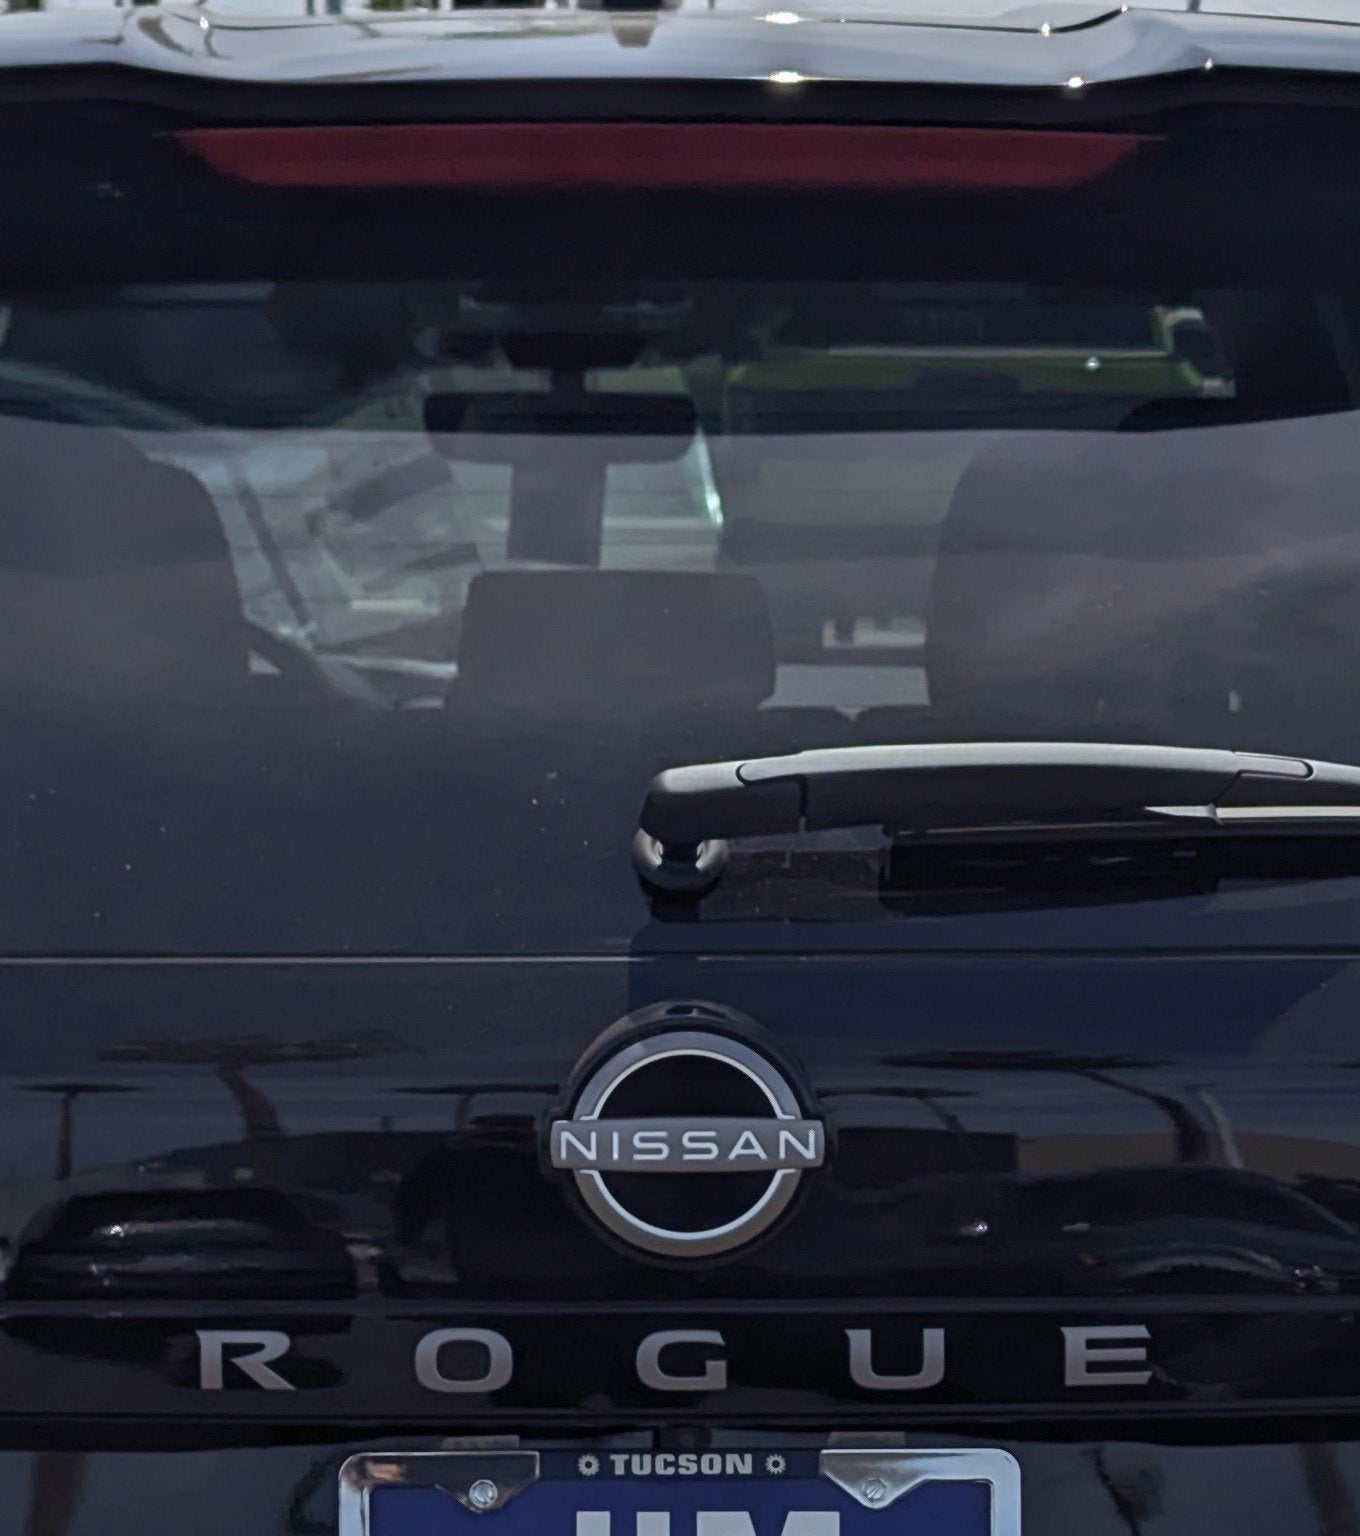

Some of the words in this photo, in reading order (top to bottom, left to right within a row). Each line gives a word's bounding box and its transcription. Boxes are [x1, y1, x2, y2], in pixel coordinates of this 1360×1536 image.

[560, 1129, 816, 1161] NISSAN
[195, 1324, 1153, 1393] ROGUE
[609, 1453, 753, 1476] TUCSON
